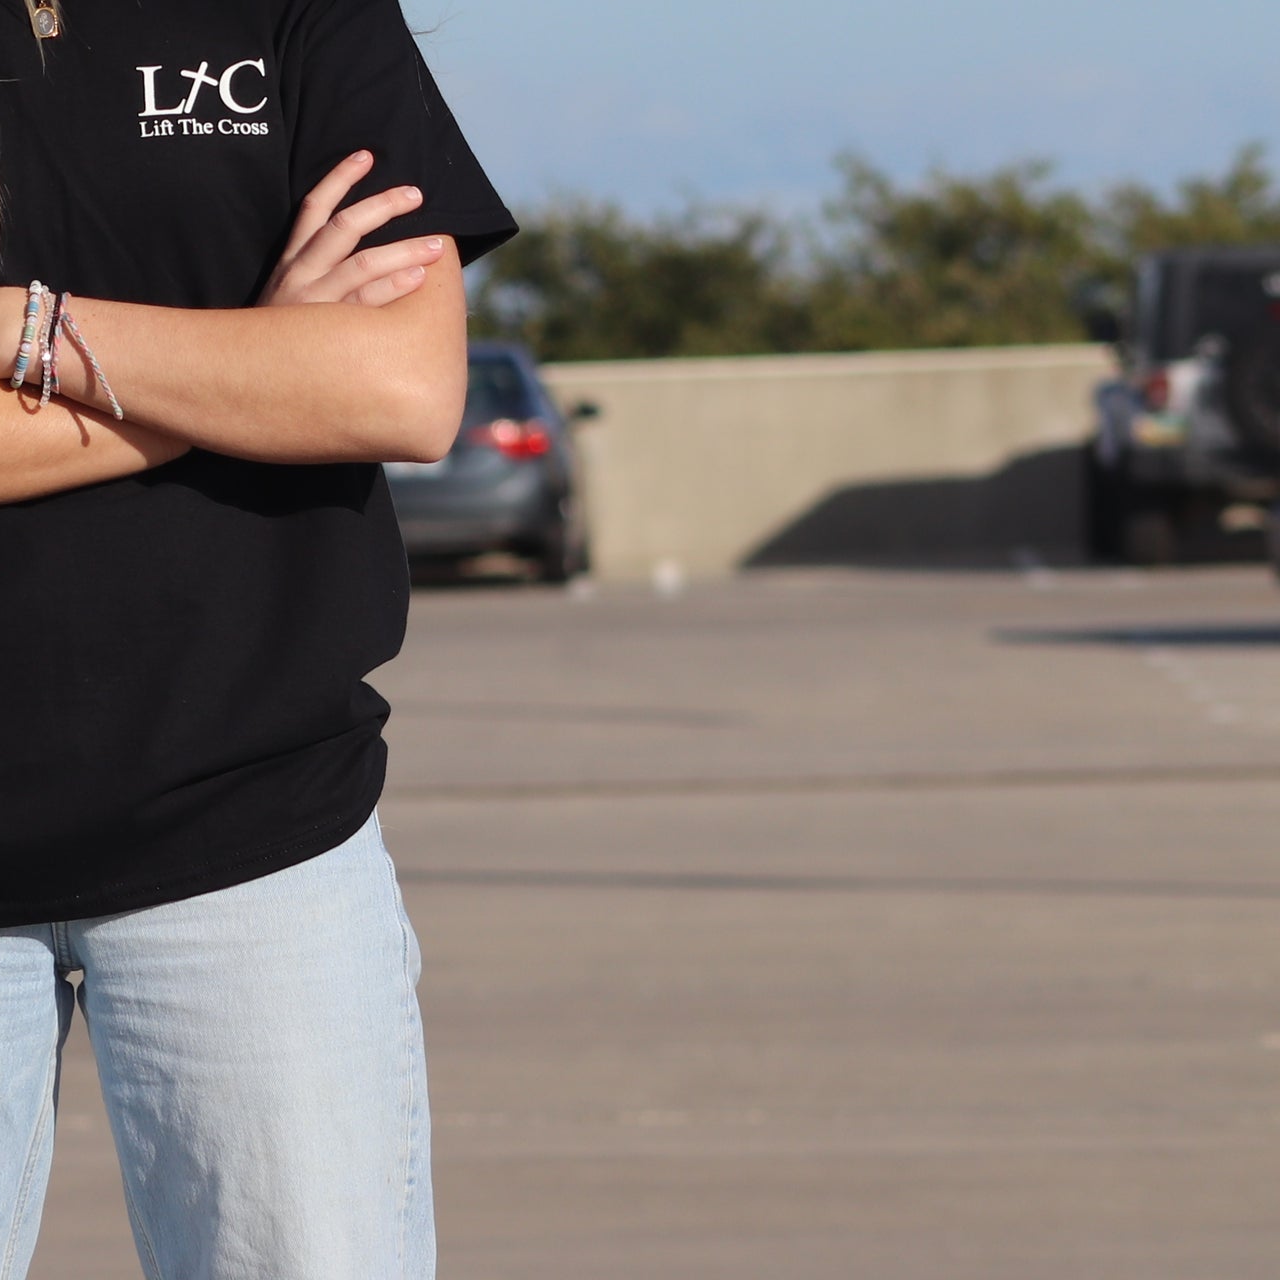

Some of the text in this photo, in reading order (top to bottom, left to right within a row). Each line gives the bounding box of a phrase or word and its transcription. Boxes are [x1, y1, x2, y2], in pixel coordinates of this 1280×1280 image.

[139, 118, 269, 138] Lift The Cross
